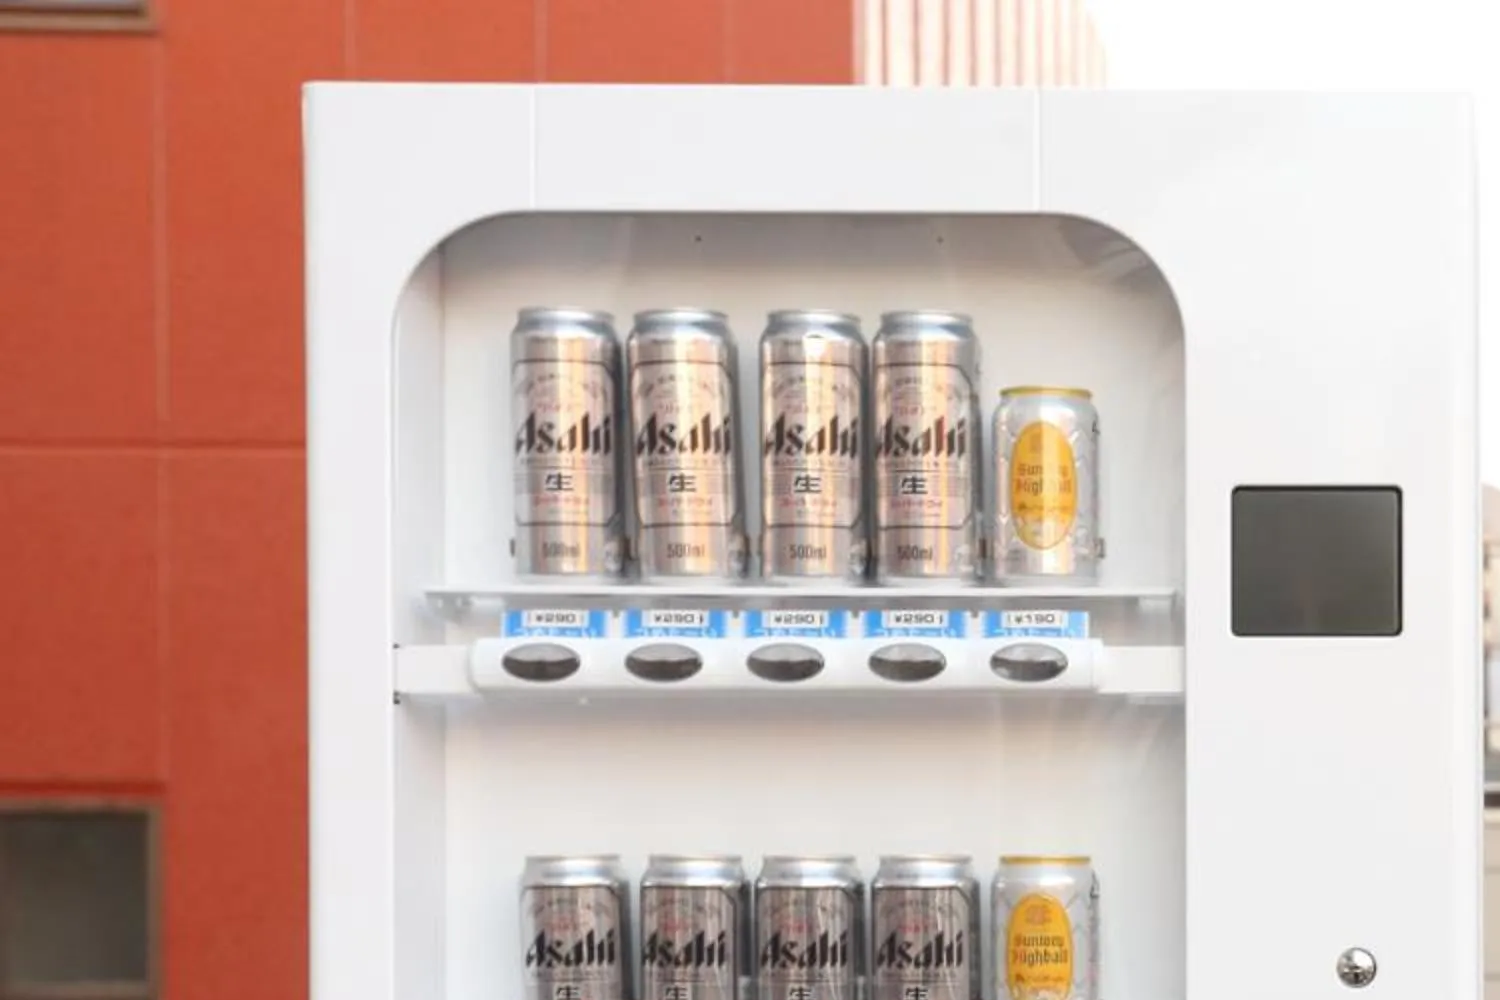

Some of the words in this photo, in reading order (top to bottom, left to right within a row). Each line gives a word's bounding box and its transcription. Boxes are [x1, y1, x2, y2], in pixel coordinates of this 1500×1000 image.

[515, 411, 612, 455] Asahi
[636, 411, 732, 456] Asahi
[764, 412, 859, 459] Asahi
[876, 414, 967, 459] Asahi
[545, 472, 574, 492] 生
[668, 473, 697, 493] 生
[793, 474, 823, 495] 生
[900, 475, 929, 496] 生
[526, 928, 615, 968] Asahi
[641, 929, 727, 969] Asahi
[761, 930, 848, 969] Asahi
[877, 931, 963, 970] Asahi
